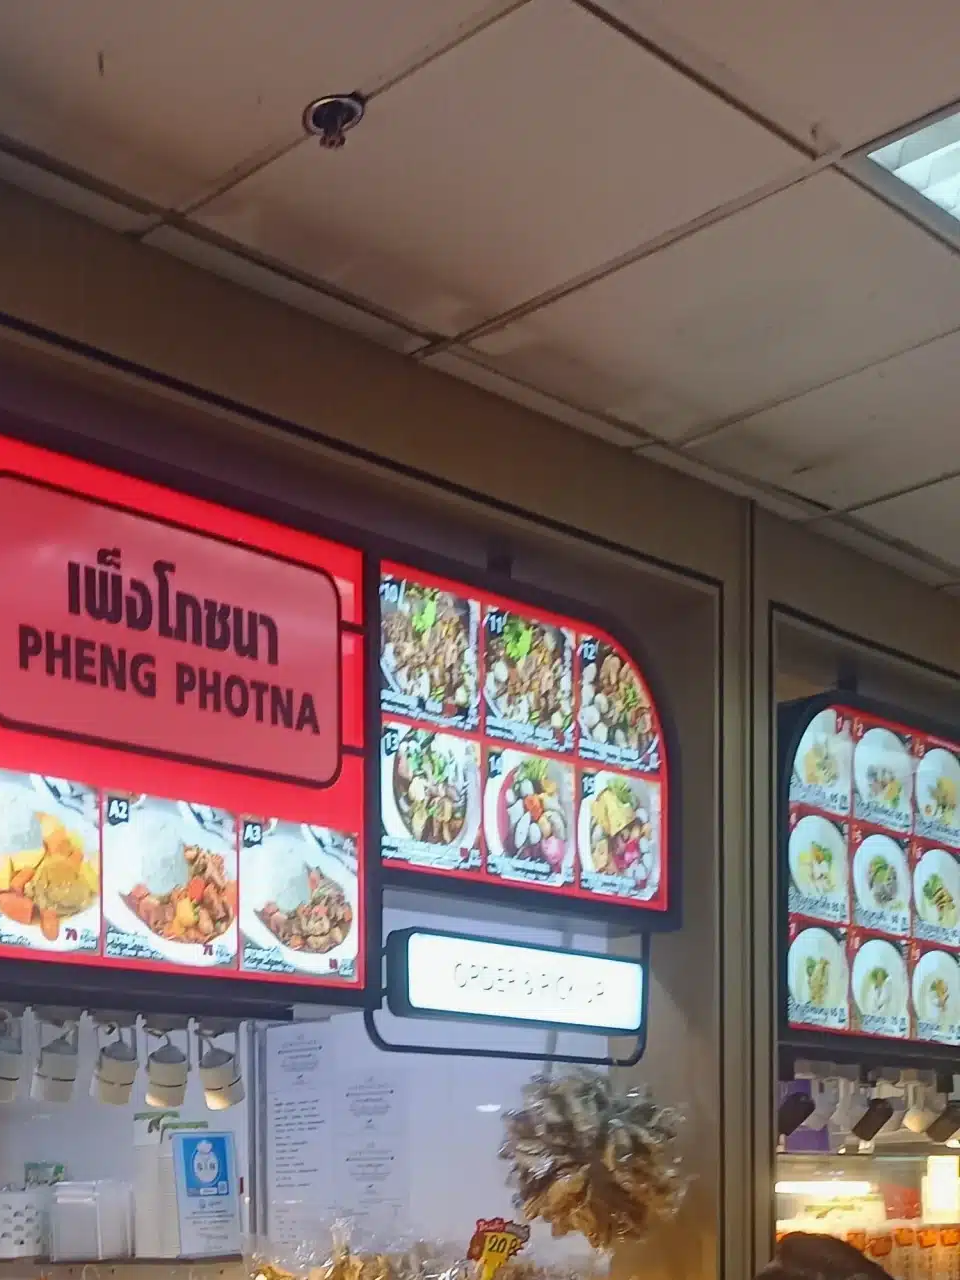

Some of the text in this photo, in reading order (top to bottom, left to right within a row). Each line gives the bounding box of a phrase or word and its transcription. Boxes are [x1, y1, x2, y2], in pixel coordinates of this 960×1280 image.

[66, 547, 279, 665] เพ็งโภชนา
[17, 623, 157, 698] PHENG
[175, 661, 321, 735] PHOTNA
[109, 801, 128, 821] A2
